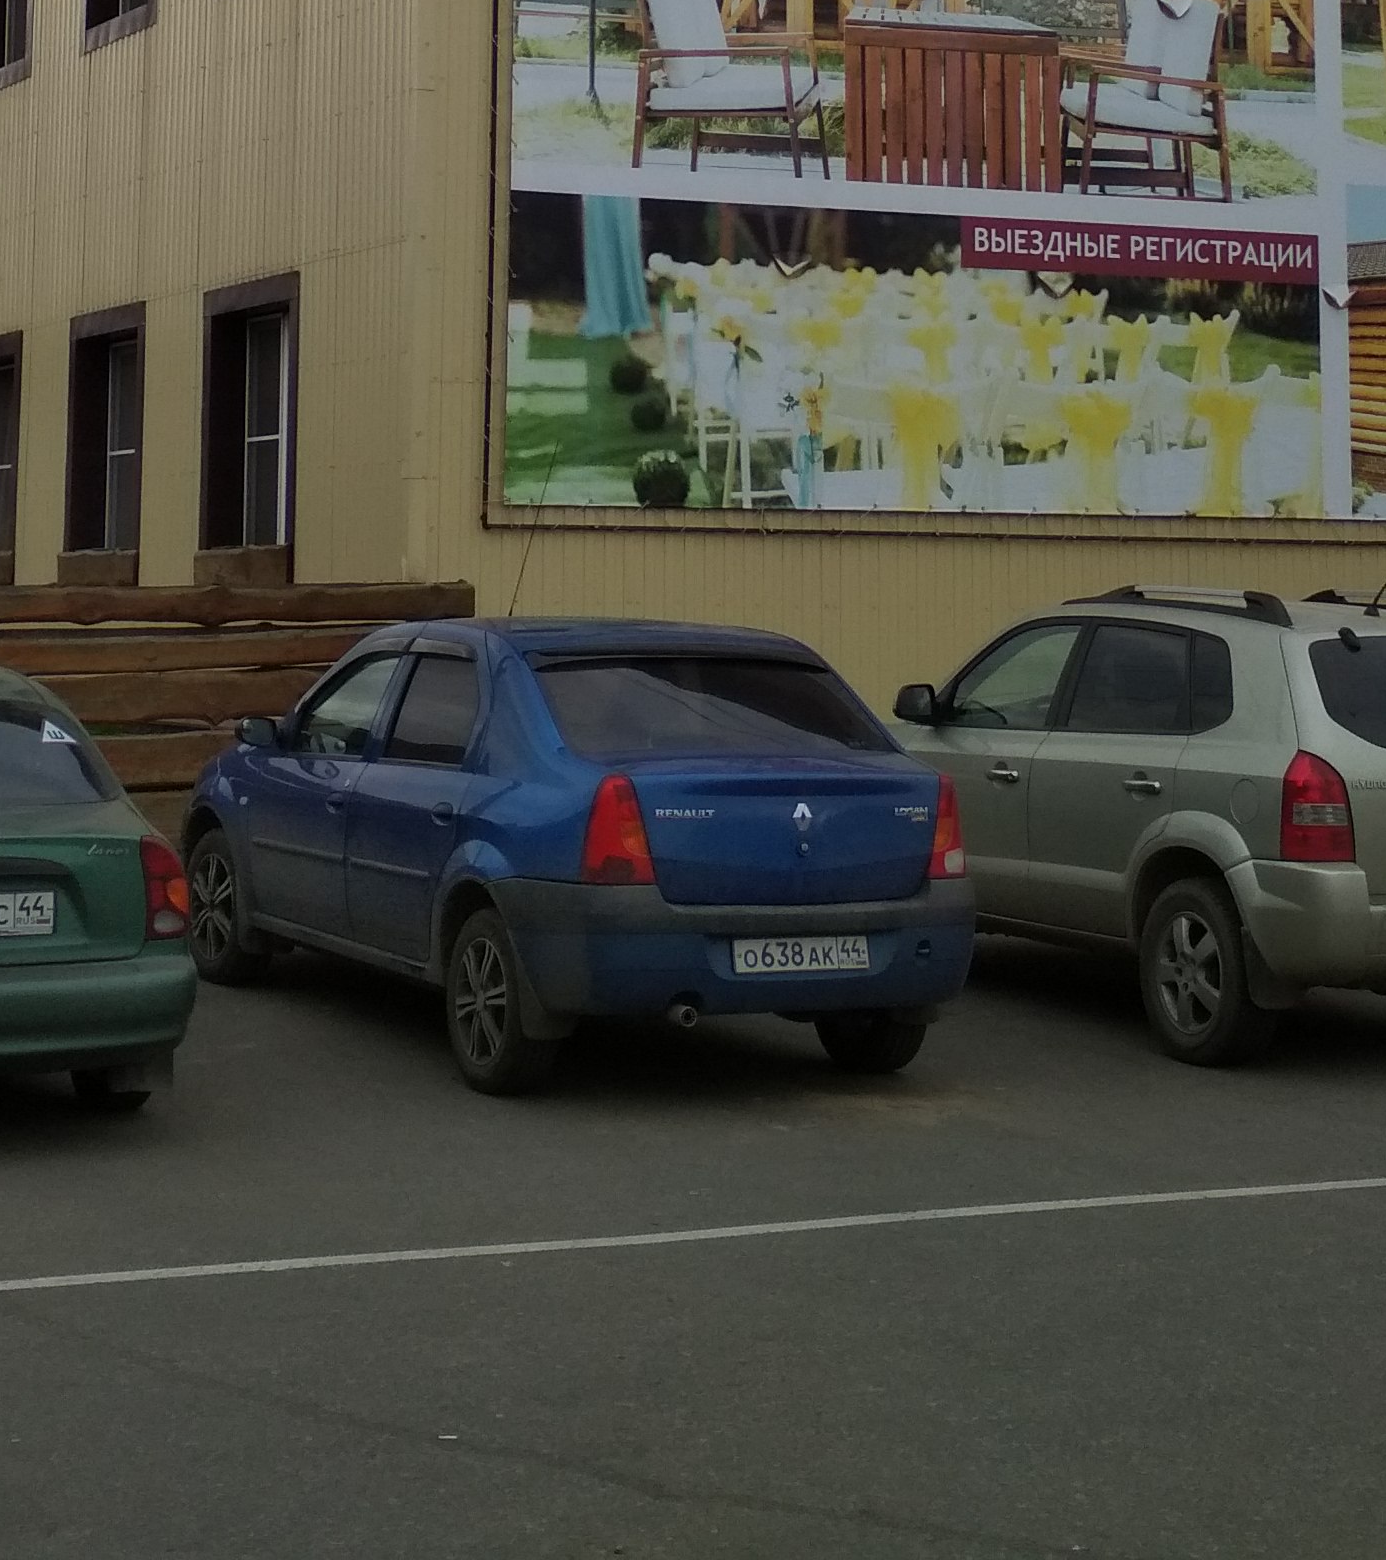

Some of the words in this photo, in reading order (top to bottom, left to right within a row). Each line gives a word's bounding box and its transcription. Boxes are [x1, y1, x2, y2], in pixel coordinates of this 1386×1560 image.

[973, 226, 1121, 262] ВЫЕЗДНЫЕ
[1130, 234, 1314, 272] РЕГИСТРАЦИИ
[654, 806, 716, 818] RENAULT
[18, 893, 45, 916] 44
[839, 937, 861, 957] 44
